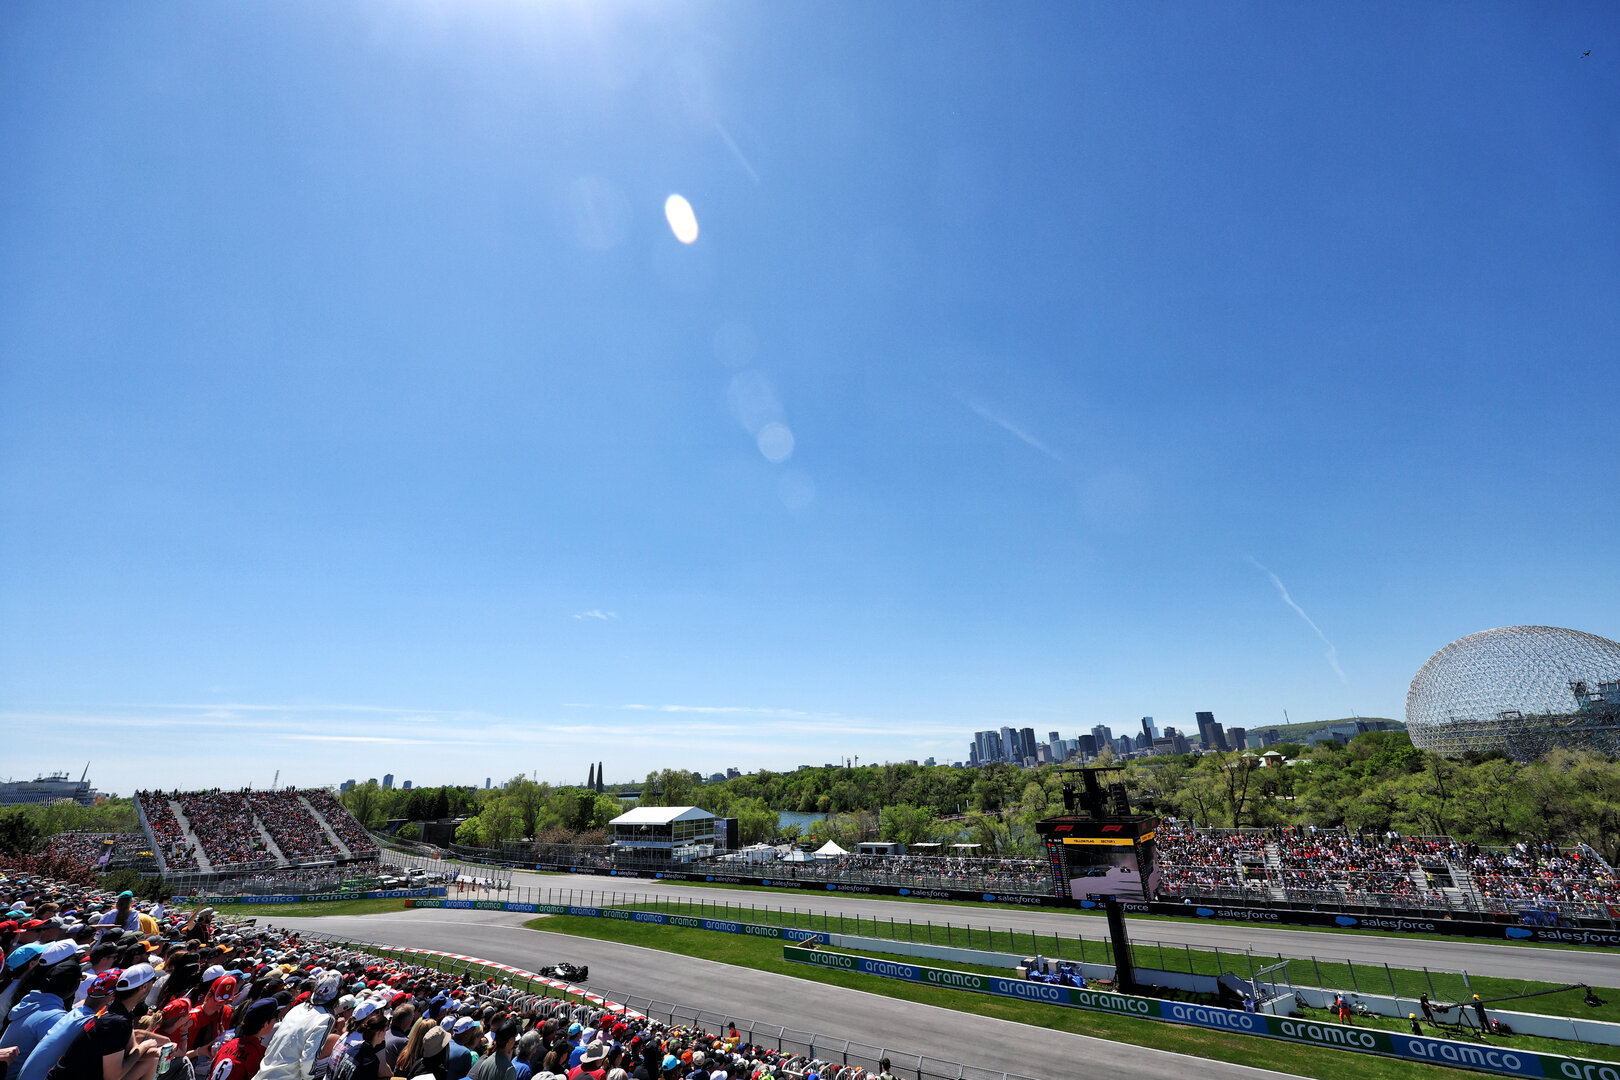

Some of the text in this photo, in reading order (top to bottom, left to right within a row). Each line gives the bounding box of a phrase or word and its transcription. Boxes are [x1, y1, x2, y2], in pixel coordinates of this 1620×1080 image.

[772, 880, 800, 888] salesforce
[838, 884, 870, 892] salesforce
[376, 889, 428, 898] aramco
[912, 889, 949, 898] salesforce
[998, 895, 1040, 904] salesforce
[508, 903, 532, 911] aramco
[571, 908, 596, 916] aramco
[1098, 902, 1149, 911] sforce
[603, 910, 628, 919] aramco
[636, 912, 662, 922] aramco
[1218, 909, 1278, 920] salesforce
[670, 916, 698, 927] aramco
[706, 920, 736, 932] aramco
[1361, 918, 1434, 930] salesforce
[746, 925, 778, 936] aramco
[1538, 930, 1620, 943] salesforc
[810, 952, 852, 967] aramco
[866, 961, 912, 978] aramco
[928, 971, 980, 988] aramco
[999, 981, 1058, 999] aramco
[1080, 992, 1148, 1013] aramco
[1173, 1006, 1252, 1029] aramco
[1281, 1022, 1376, 1048] aramco
[1408, 1040, 1521, 1070] aramco
